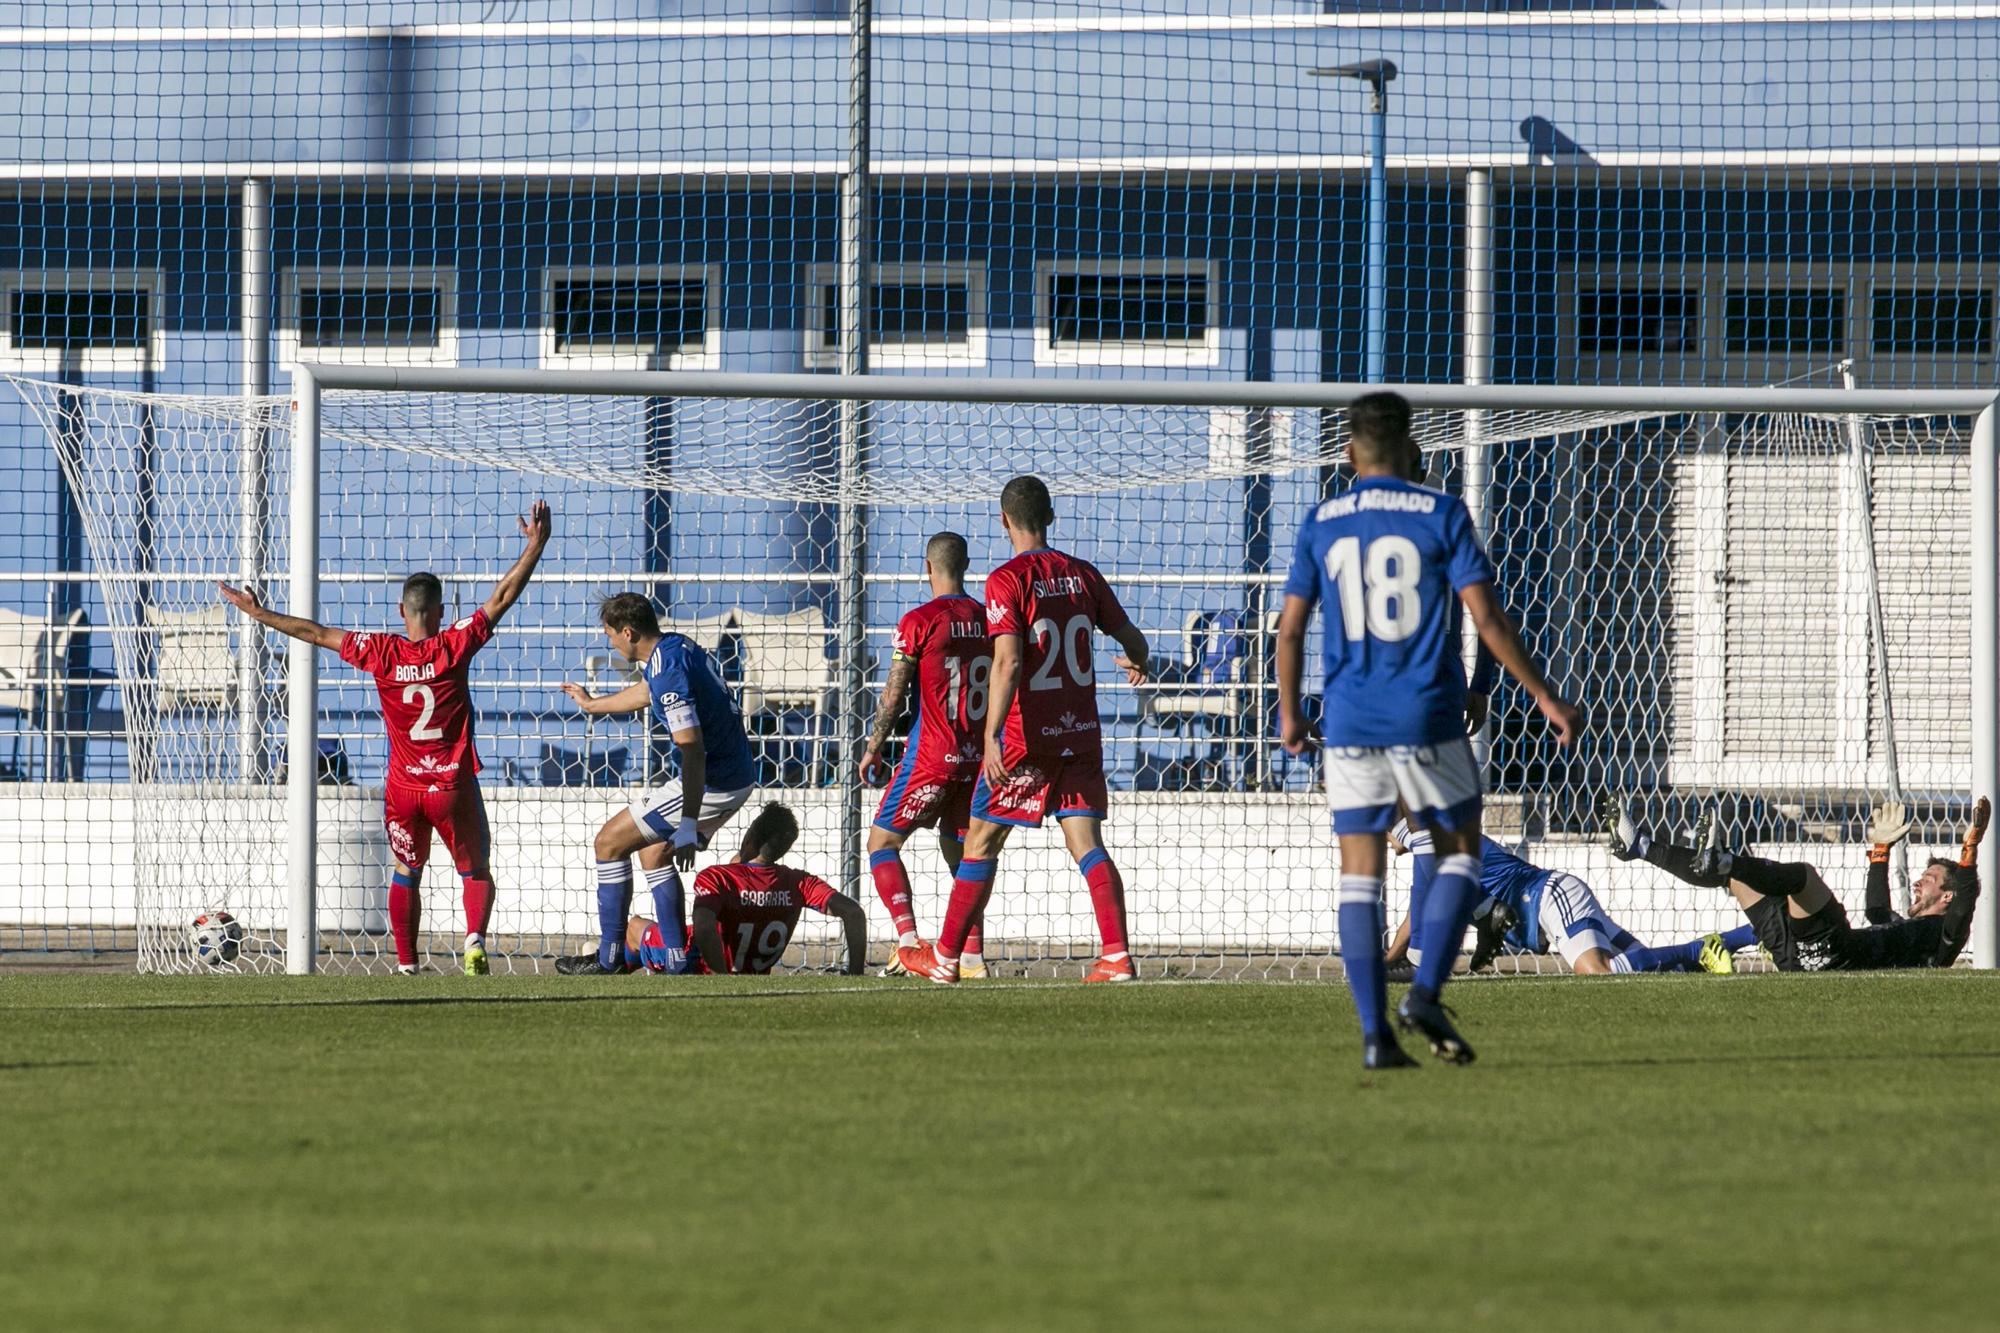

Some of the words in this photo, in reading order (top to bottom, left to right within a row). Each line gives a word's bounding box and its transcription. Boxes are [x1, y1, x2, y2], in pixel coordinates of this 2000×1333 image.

[1034, 576, 1083, 598] SILLERO
[1324, 535, 1421, 642] 18
[1029, 614, 1094, 691] 20
[396, 663, 435, 682] BORJA
[944, 655, 992, 721] 18
[402, 684, 443, 741] 2
[1042, 724, 1063, 736] Caja
[1075, 720, 1097, 731] Soria
[405, 765, 424, 776] Caja
[436, 760, 460, 773] Soria
[944, 754, 965, 764] Caja
[740, 889, 793, 906] GABARRE
[734, 921, 788, 972] 19
